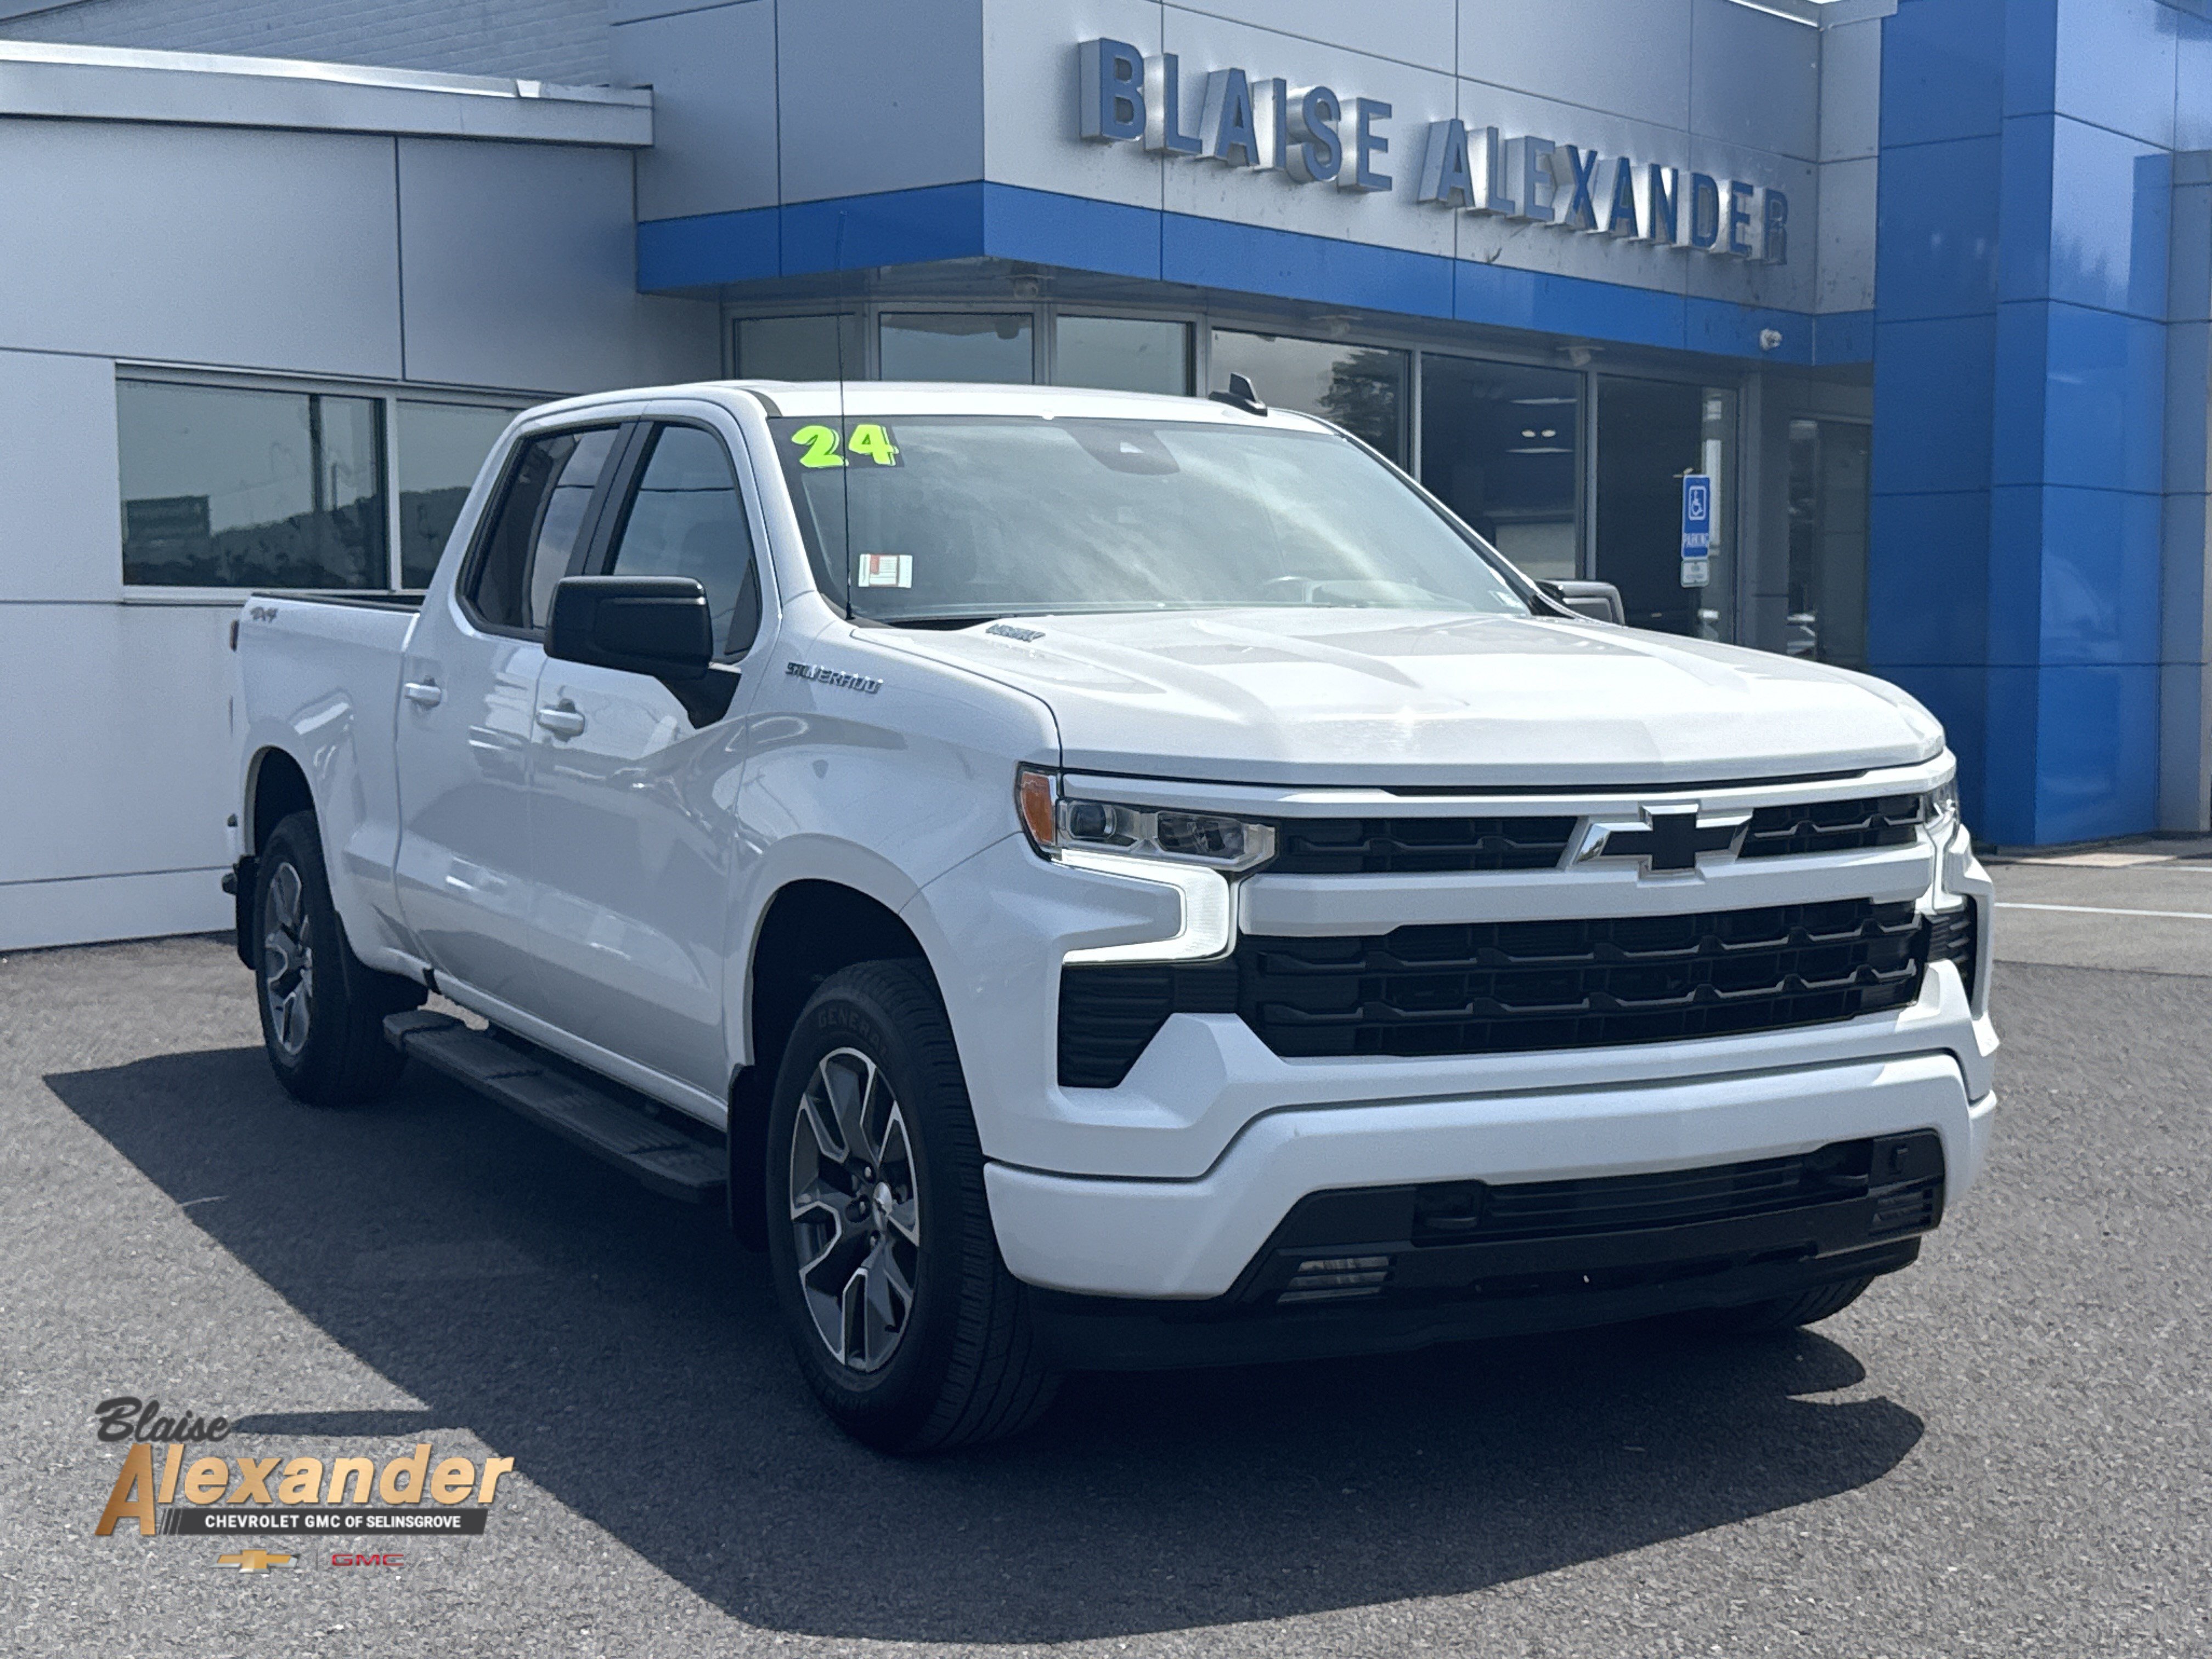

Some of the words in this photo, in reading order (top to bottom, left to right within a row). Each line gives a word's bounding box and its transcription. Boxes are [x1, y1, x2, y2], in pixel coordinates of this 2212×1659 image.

[1079, 37, 1393, 193] BLAISE
[1418, 118, 1790, 265] ALEXANDER
[792, 424, 899, 468] 24
[785, 662, 884, 695] SILVERADO
